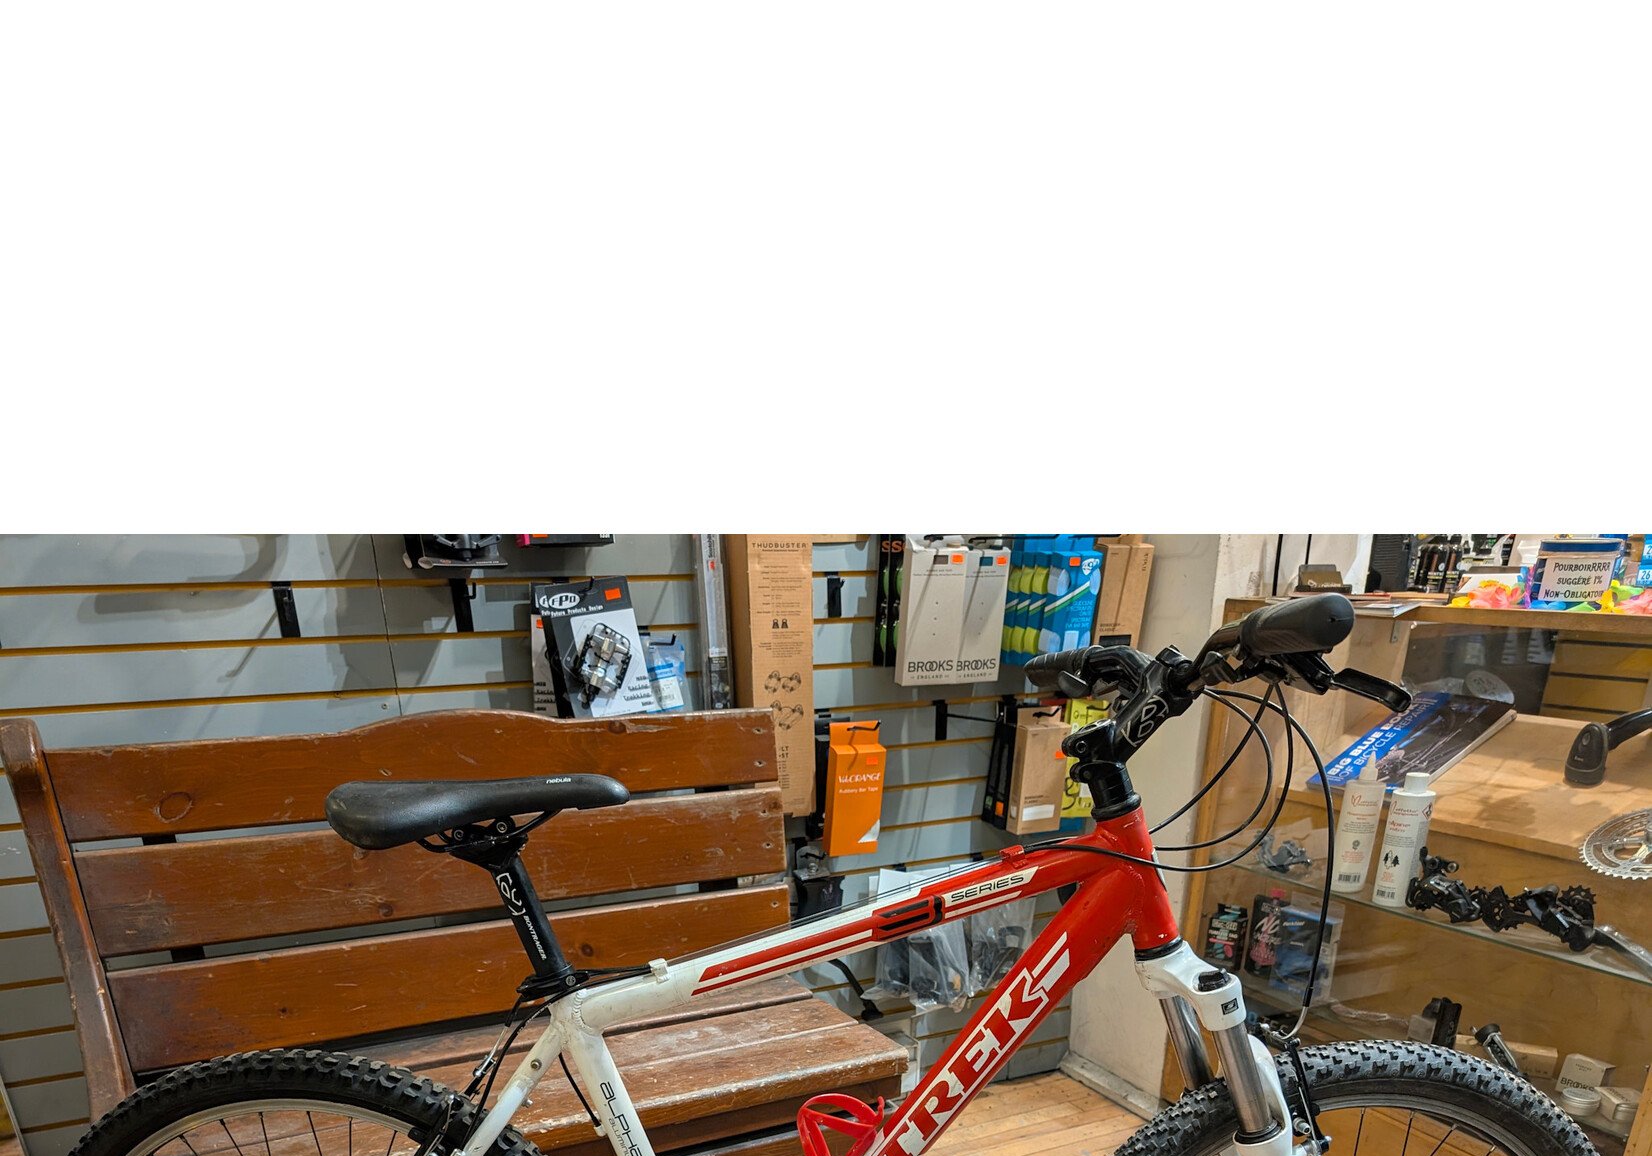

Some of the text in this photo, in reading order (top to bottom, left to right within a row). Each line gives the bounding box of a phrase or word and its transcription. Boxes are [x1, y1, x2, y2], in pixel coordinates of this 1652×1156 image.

[1641, 570, 1650, 580] 26
[907, 660, 954, 673] BROOKS
[956, 659, 996, 671] BROOKS
[1327, 757, 1352, 776] BIG
[1349, 731, 1384, 757] BLUE
[1339, 766, 1353, 779] OF
[1353, 730, 1397, 766] BICYCLE
[951, 874, 1024, 903] SERIES
[523, 915, 547, 961] BONTRAGER
